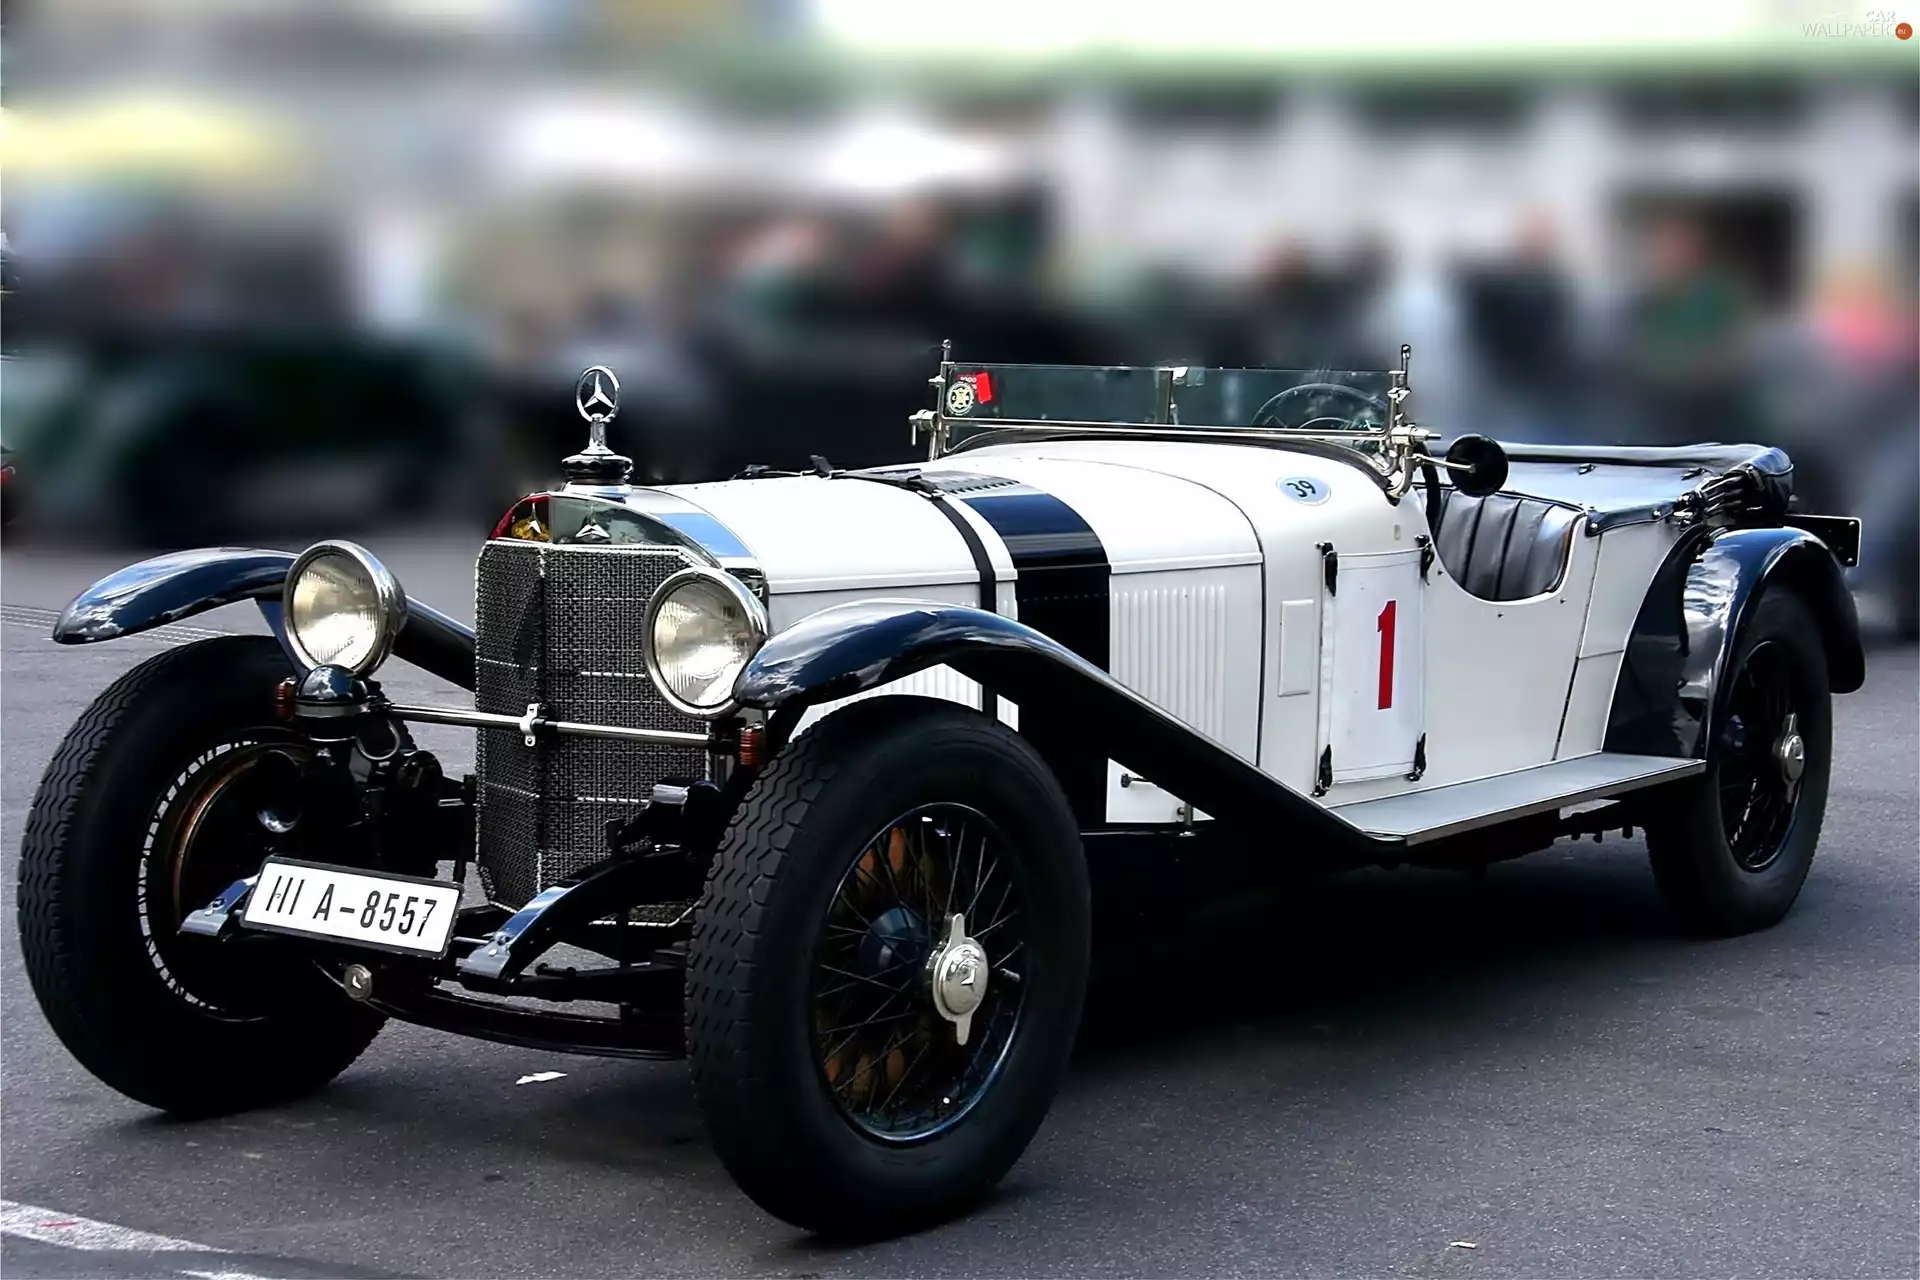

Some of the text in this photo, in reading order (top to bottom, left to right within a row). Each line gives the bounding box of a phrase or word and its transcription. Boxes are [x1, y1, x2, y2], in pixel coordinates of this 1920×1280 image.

[1286, 480, 1316, 498] 39
[1377, 600, 1397, 710] 1
[312, 883, 437, 937] A-8557
